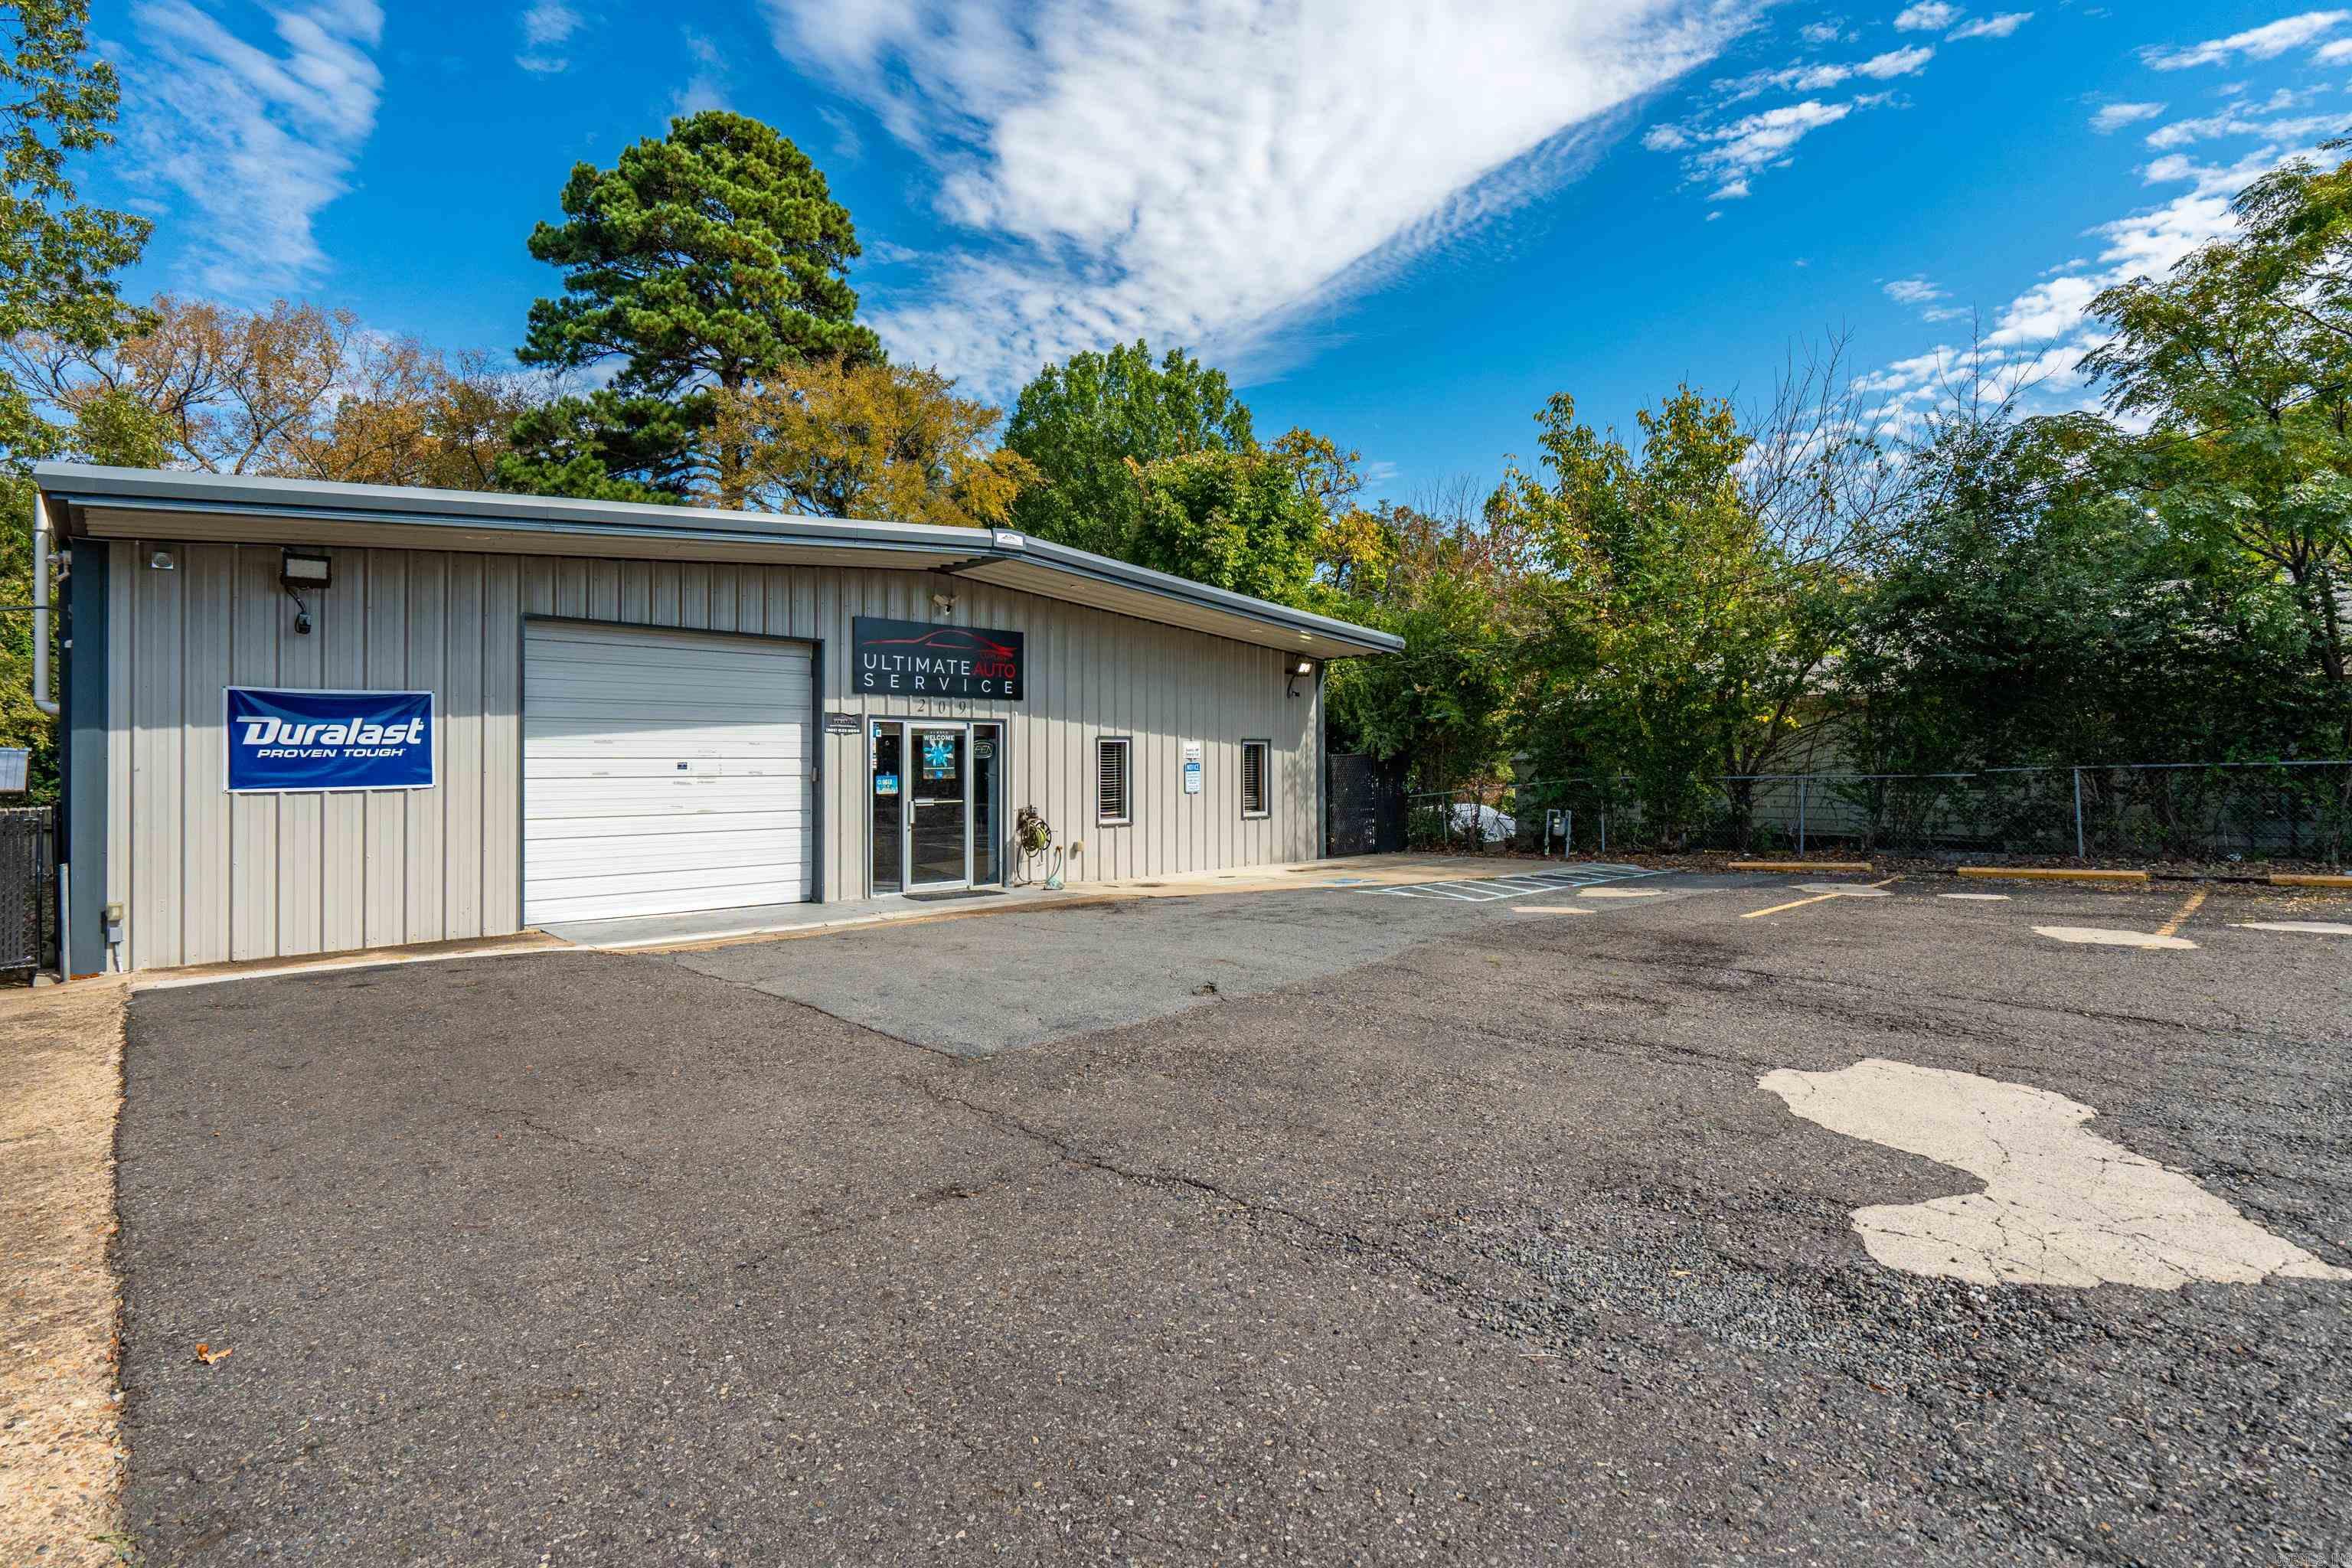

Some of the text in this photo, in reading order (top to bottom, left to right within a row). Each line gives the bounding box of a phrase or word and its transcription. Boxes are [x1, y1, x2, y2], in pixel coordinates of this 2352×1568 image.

[864, 653, 1017, 678] ULTIMATE AUTO
[864, 673, 1013, 694] SERVICE
[917, 698, 966, 714] 209
[236, 716, 424, 745] Duralast
[256, 748, 405, 758] PROVEN TOUGH
